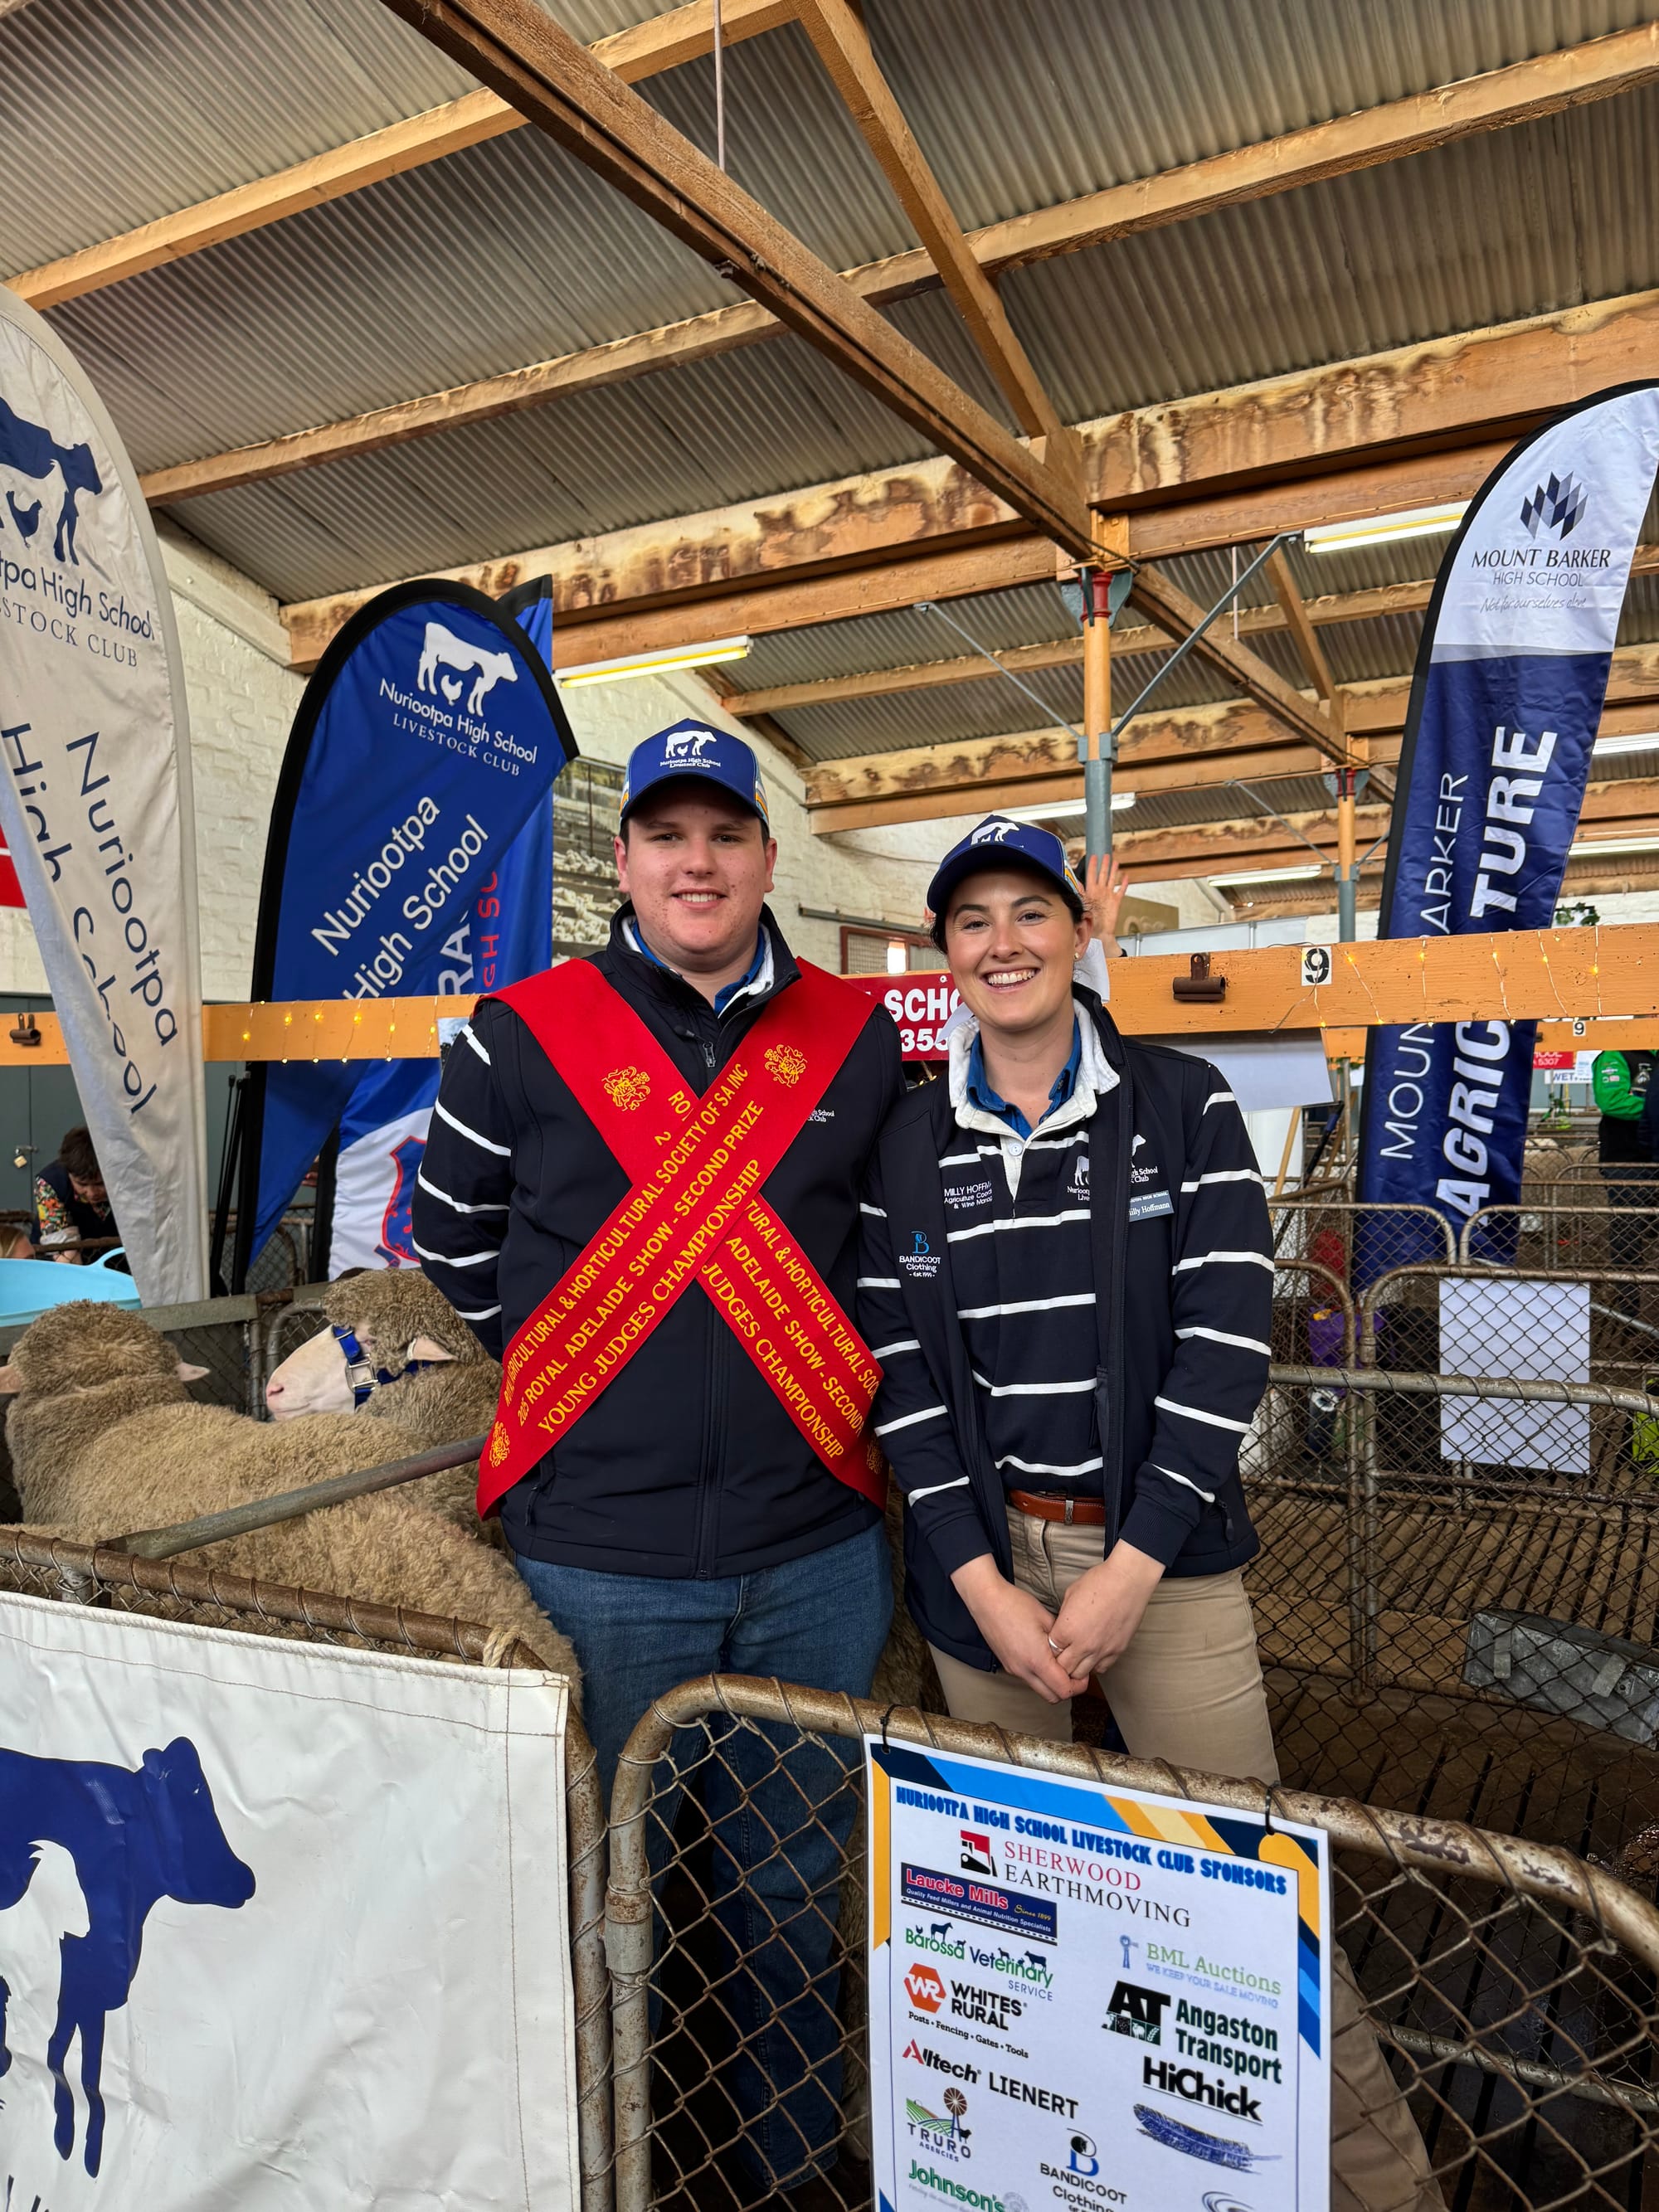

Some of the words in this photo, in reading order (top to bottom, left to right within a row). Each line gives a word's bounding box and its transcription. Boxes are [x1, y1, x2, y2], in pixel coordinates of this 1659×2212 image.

[1472, 549, 1542, 568] MOUNT
[1545, 549, 1611, 568] BARKER
[1493, 571, 1524, 585] HIGH
[1526, 571, 1584, 587] SCHOOL
[41, 566, 92, 618] High
[99, 591, 155, 641] School
[1480, 597, 1500, 613] Not
[87, 633, 138, 668] CLUB
[379, 677, 453, 728] Nuriootpa
[457, 714, 490, 744] High
[494, 730, 538, 764] School
[392, 712, 478, 759] LIVESTOCK
[483, 751, 520, 776] CLUB
[66, 731, 178, 1046] Nuriootpa
[310, 796, 440, 956] Nuriootpa
[342, 931, 413, 999] High
[402, 813, 489, 931] School
[1304, 948, 1330, 984] 9
[1380, 1023, 1435, 1159] MOUN
[1419, 772, 1468, 938] ARKER
[1574, 1022, 1584, 1035] 9
[713, 1085, 735, 1107] SA
[726, 1063, 748, 1090] INC
[699, 1101, 721, 1125] OF
[655, 1121, 707, 1184] SOCIETY
[1139, 1166, 1158, 1174] School
[944, 1186, 965, 1197] MILLY
[1134, 1174, 1149, 1183] Club
[1141, 1203, 1170, 1213] Hoffmann
[524, 1359, 569, 1404] ROYAL
[563, 1276, 635, 1359] ADELAIDE
[628, 1221, 674, 1276] SHOW
[674, 1148, 729, 1217] SECOND
[722, 1100, 764, 1151] PRIZE
[566, 1182, 664, 1299] HORTICULTURAL
[774, 1247, 791, 1263] &
[899, 1256, 941, 1264] BANDICOOT
[906, 1263, 937, 1273] Clothing
[538, 1372, 597, 1434] YOUNG
[593, 1301, 656, 1375] JUDGES
[652, 1159, 761, 1301] CHAMPIONSHIP
[558, 1296, 577, 1310] &
[782, 1257, 865, 1373] HORTICULTURAL
[725, 1237, 791, 1320] ADELAIDE
[784, 1320, 826, 1370] SHOW
[822, 1377, 863, 1430] SECOND
[702, 1262, 761, 1338] JUDGES
[756, 1339, 844, 1458] CHAMPIONSHIP
[897, 1786, 969, 1821] NURIOOTPA
[973, 1805, 1010, 1830] HIGH
[1014, 1816, 1068, 1845] SCHOOL
[1072, 1829, 1153, 1866] LIVESTOCK
[1156, 1850, 1194, 1874] CLUB
[1200, 1858, 1287, 1895] SPONSORS
[1005, 1840, 1141, 1891] SHERWOOD
[906, 1868, 965, 1898] Laucke
[969, 1884, 1009, 1910] Mills
[1014, 1904, 1036, 1918] Since
[1037, 1913, 1052, 1922] 1899
[906, 1888, 926, 1899] Quality
[927, 1893, 941, 1902] Feed
[941, 1896, 960, 1908] Millers
[972, 1906, 992, 1917] Animal
[994, 1911, 1019, 1923] Nutrition
[1019, 1918, 1051, 1933] Specialists
[1005, 1863, 1191, 1928] EARTHMOVING
[905, 1928, 966, 1960] Barossa
[970, 1946, 1053, 1989] Veterinary
[1146, 1942, 1190, 1969] BML
[1194, 1956, 1282, 1996] Auctions
[1146, 1962, 1160, 1973] WE
[1186, 1974, 1211, 1989] YOUR
[1214, 1981, 1238, 1996] SALE
[951, 1980, 1023, 2017] WHITES
[1008, 1980, 1053, 2002] SERVICE
[908, 2010, 930, 2025] Posts
[936, 2020, 969, 2040] Fencing
[975, 2035, 999, 2049] Gates
[1005, 2043, 1029, 2059] Tools
[951, 1998, 1010, 2031] RURAL
[1175, 1997, 1279, 2052] Angaston
[902, 2038, 978, 2084] Alltech
[1175, 2028, 1282, 2084] Transport
[989, 2072, 1078, 2119] LIENERT
[1143, 2055, 1262, 2123] HiChick
[907, 2122, 971, 2159] TRURO
[919, 2141, 959, 2162] AGENCIES
[908, 2158, 1005, 2212] Johnson's
[1040, 2162, 1127, 2205] BANDICOOT
